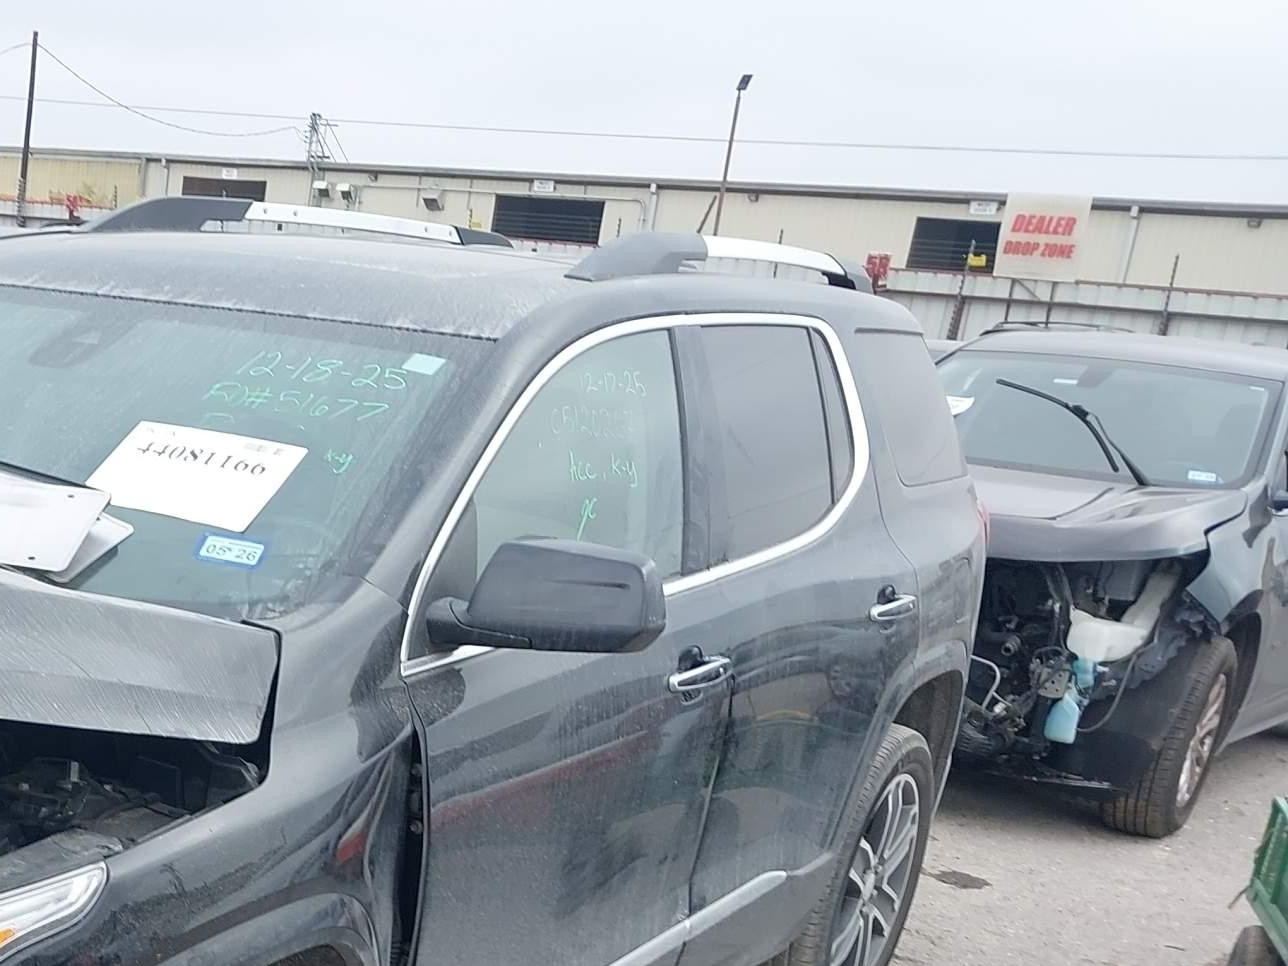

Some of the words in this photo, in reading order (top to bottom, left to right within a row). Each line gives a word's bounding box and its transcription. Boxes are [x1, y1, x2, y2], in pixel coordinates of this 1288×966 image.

[1011, 213, 1077, 236] DEALER
[1003, 240, 1040, 256] DROP
[1040, 243, 1075, 258] ZONE
[235, 350, 408, 390] 12-18-25
